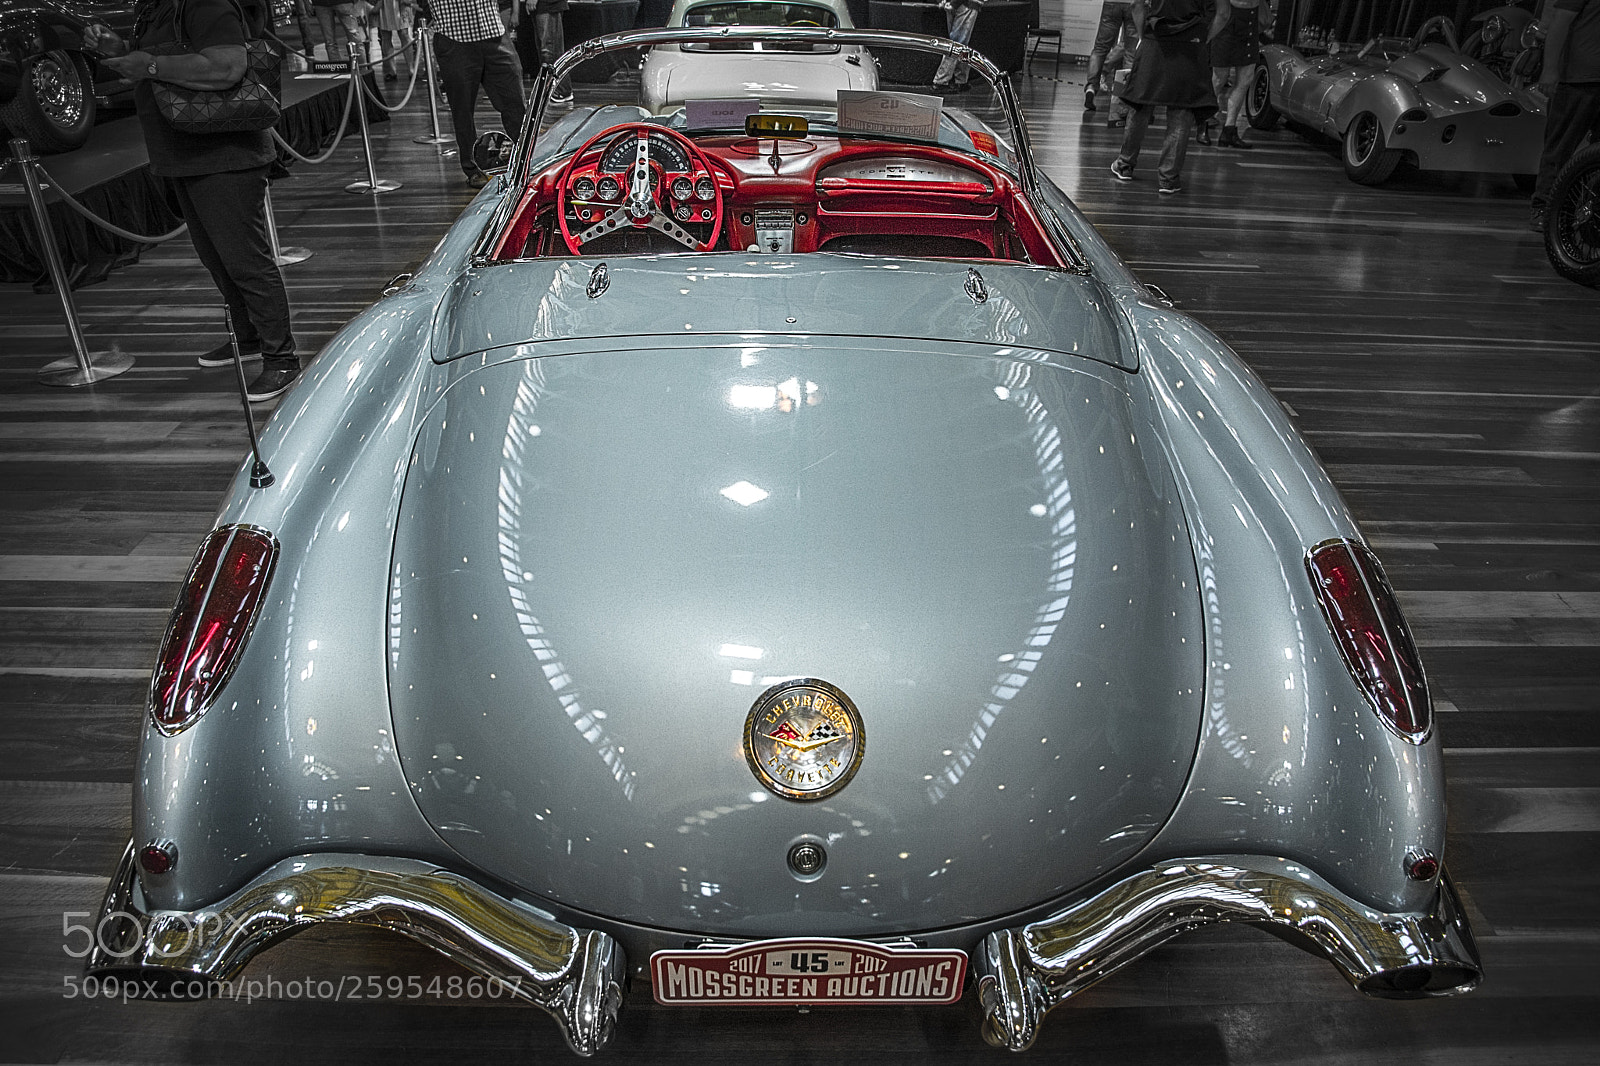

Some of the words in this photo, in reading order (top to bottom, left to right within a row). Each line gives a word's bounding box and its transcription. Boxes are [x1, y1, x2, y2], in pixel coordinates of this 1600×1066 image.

[315, 63, 348, 71] mossgreen
[765, 695, 845, 727] CHEVROLET
[729, 953, 763, 974] 2017
[790, 952, 830, 973] 45
[854, 953, 888, 974] 2017
[667, 960, 817, 998] MOSSGREEN
[827, 959, 952, 997] AUCTIONS
